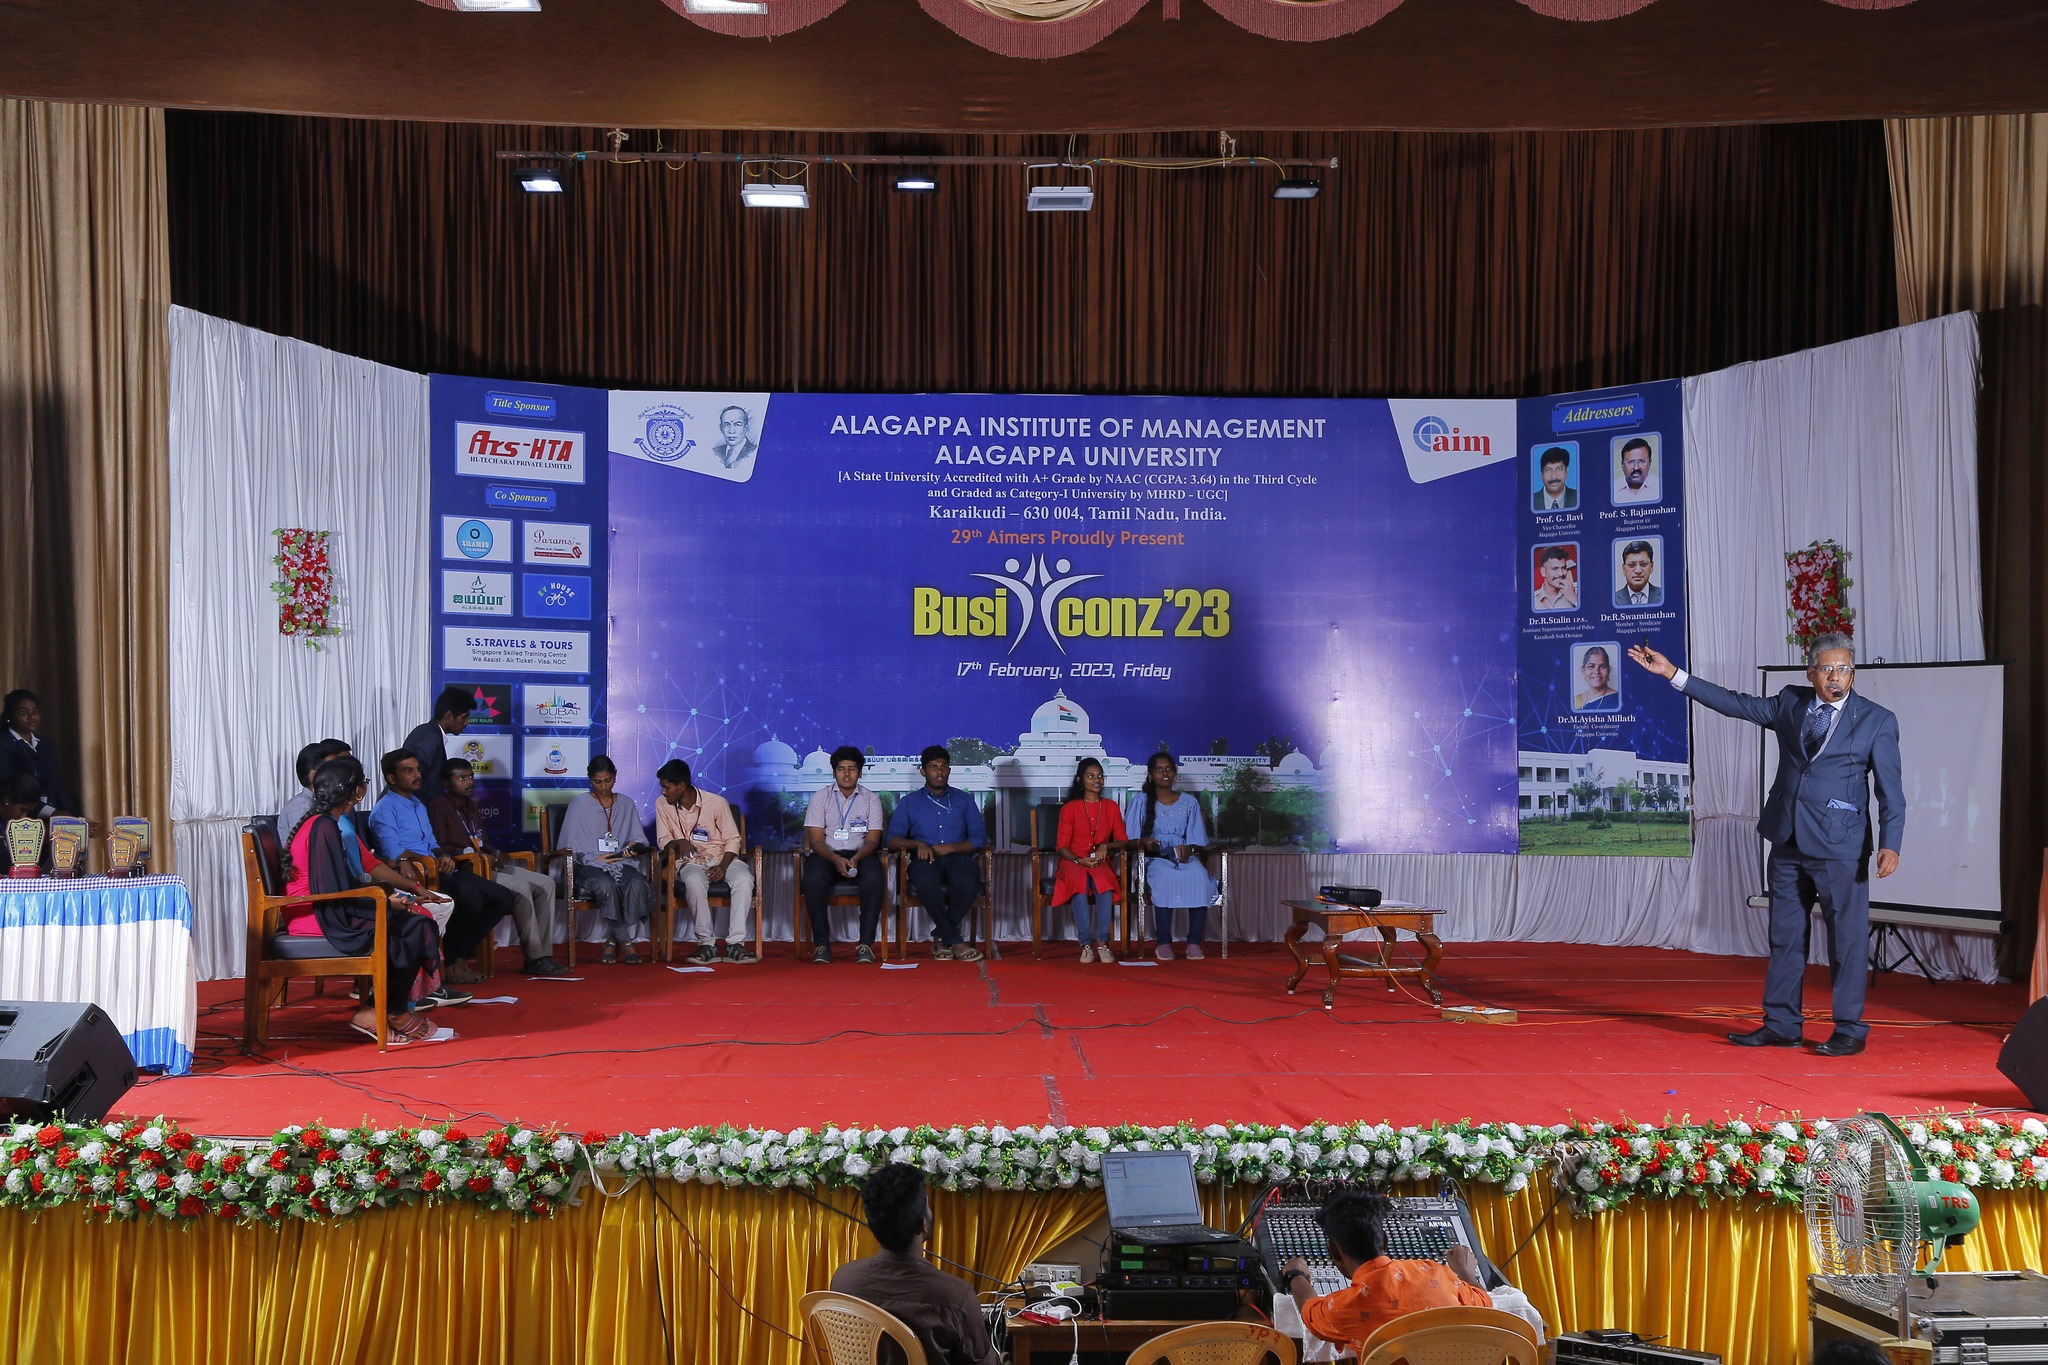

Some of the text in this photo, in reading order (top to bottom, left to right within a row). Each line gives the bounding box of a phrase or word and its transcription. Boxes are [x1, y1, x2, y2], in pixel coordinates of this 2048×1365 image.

[493, 398, 550, 412] Title Sponsor
[1563, 404, 1634, 423] Addressers
[830, 415, 1326, 439] ALAGAPPA INSTITUTE OF MANAGEMENT
[1432, 427, 1491, 456] aim
[470, 456, 573, 470] HI-TECH ARAI PRIVATE LIMITED
[935, 445, 1222, 467] ALAGAPPA UNIVERSITY
[838, 470, 1317, 487] [A State University Accredited with A+ Grade by NAAC (CGPA: 3.64) in the Third Cycle
[494, 490, 548, 503] Co Sponsors
[927, 488, 948, 498] and
[951, 488, 993, 498] Graded
[995, 490, 1007, 498] as
[1009, 489, 1069, 501] Category-I
[1072, 489, 1127, 501] University
[1130, 490, 1143, 501] by
[1146, 490, 1186, 500] MHRD
[1197, 490, 1228, 502] UGC]
[929, 505, 1006, 519] Karaikudi
[1023, 506, 1049, 520] 630
[1053, 506, 1084, 522] 004,
[1088, 507, 1131, 521] Tamil
[1134, 507, 1180, 523] Nadu,
[1183, 507, 1227, 521] India.
[1536, 516, 1554, 524] Prof.
[1567, 513, 1583, 521] Ravi
[1599, 511, 1618, 519] Prof.
[1630, 506, 1676, 517] Rajamohan
[951, 529, 1185, 548] 29th Aimers Proudly Present
[538, 582, 576, 598] EV HOUSE
[913, 586, 1007, 637] Busi
[1600, 611, 1676, 622] Dr.R.Swaminathan
[1529, 616, 1571, 625] Dr.R.Stalin
[466, 637, 573, 650] S.S.TRAVELS & TOURS
[472, 649, 502, 657] Singapore
[957, 662, 1172, 680] 17th February, 2023, Friday
[539, 707, 578, 716] DUBAI
[1558, 714, 1636, 724] Dr.M.Ayisha Millath
[479, 806, 500, 818] raja
[1836, 1193, 1856, 1213] TRS
[1941, 1196, 1970, 1210] TRS
